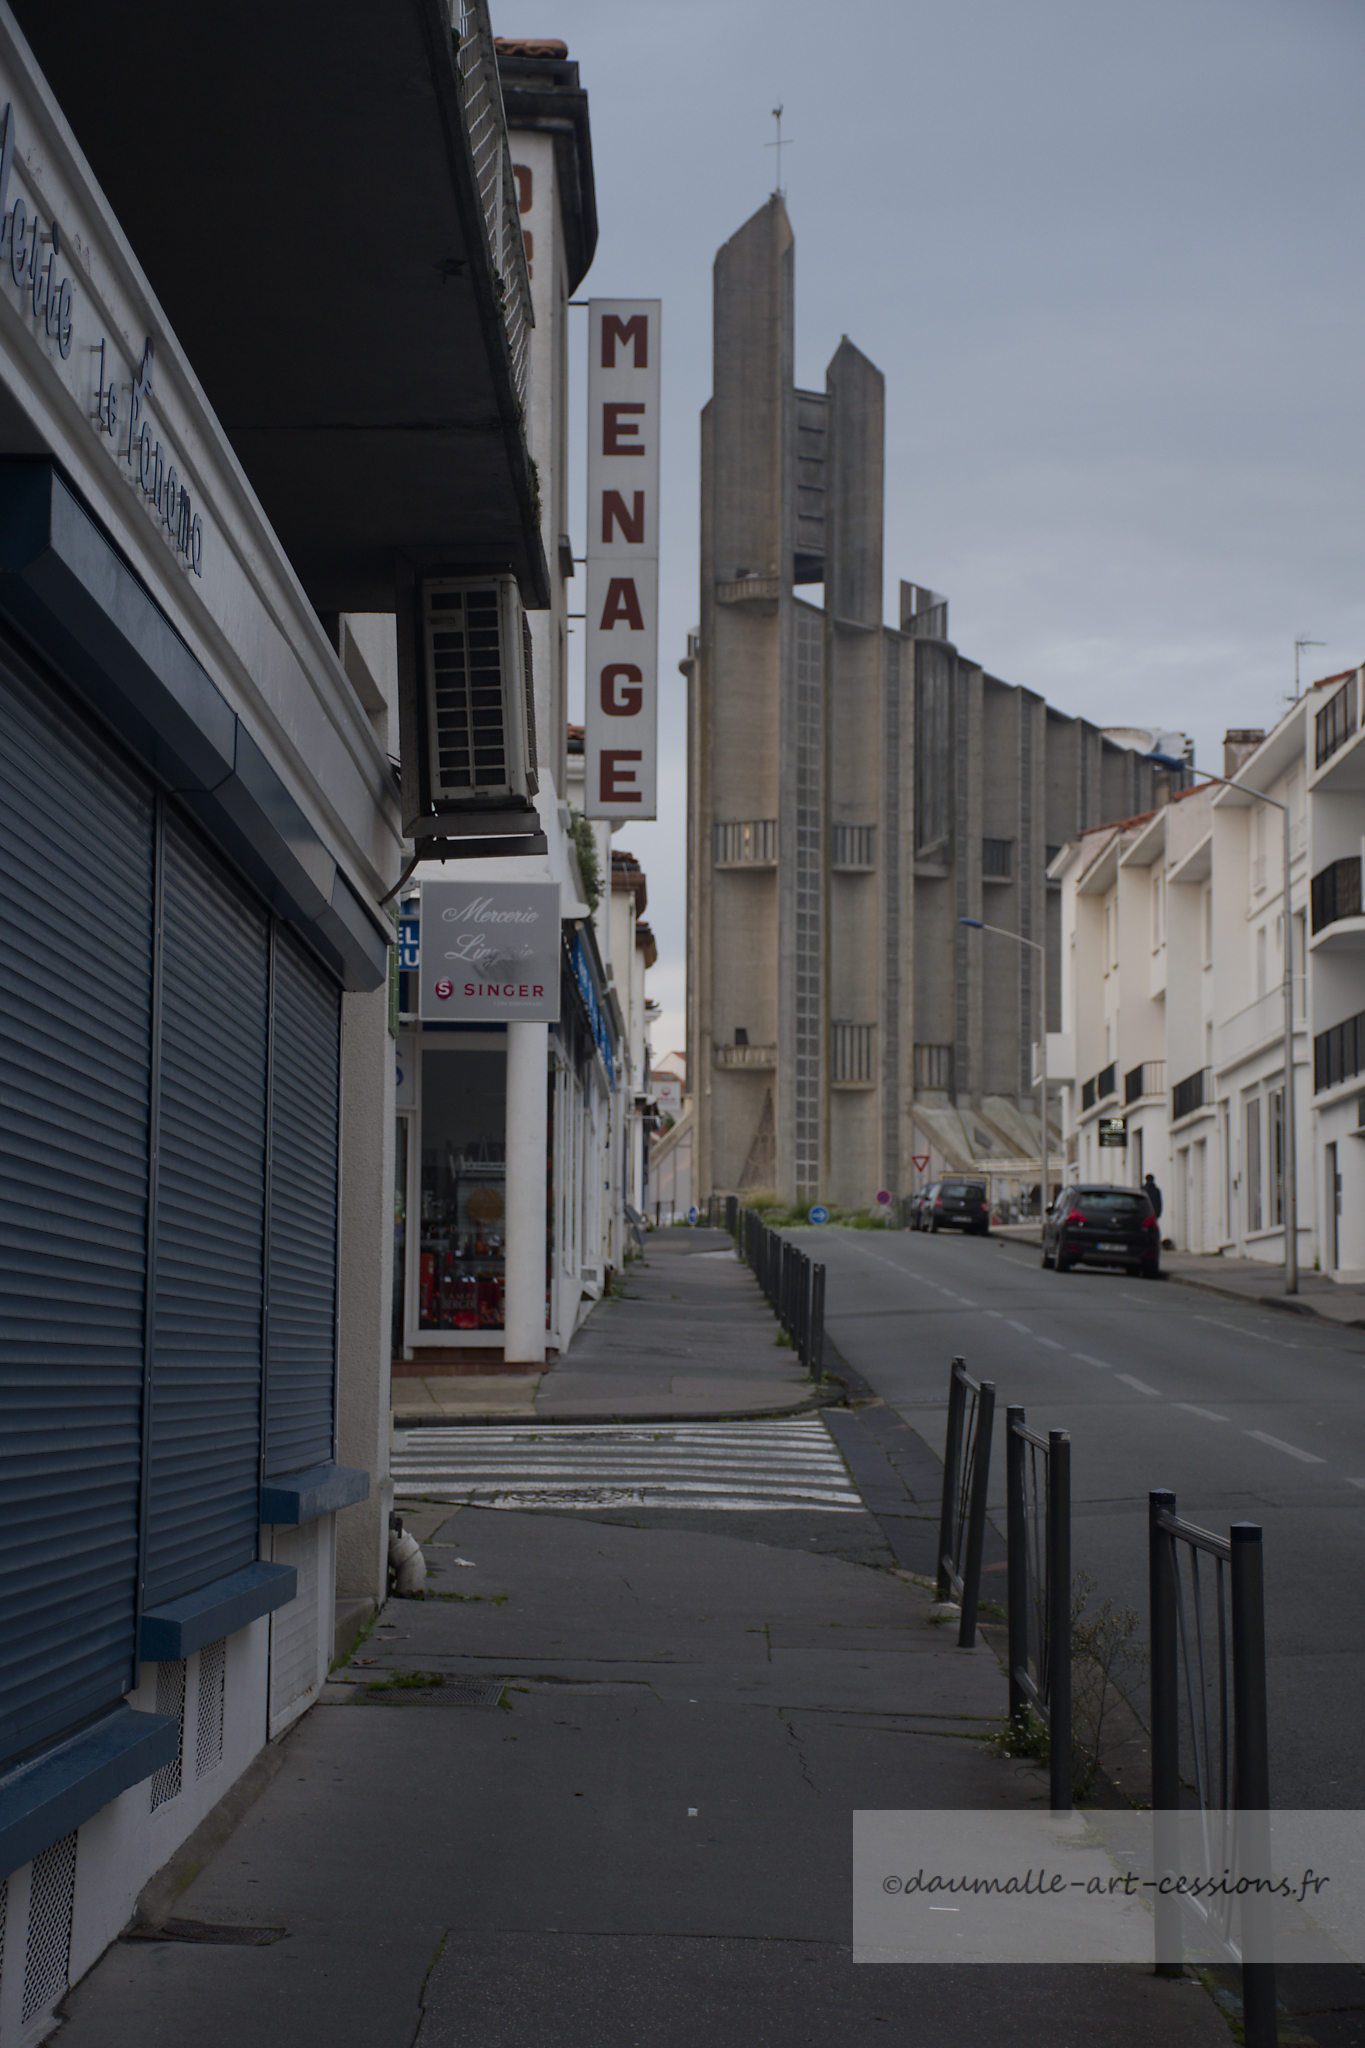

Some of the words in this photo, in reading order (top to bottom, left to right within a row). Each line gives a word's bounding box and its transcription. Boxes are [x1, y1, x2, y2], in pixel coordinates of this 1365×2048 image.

[599, 314, 649, 803] MENAGE
[441, 896, 540, 924] Mercerie
[464, 983, 544, 998] SINGER
[442, 1300, 478, 1310] BERGER
